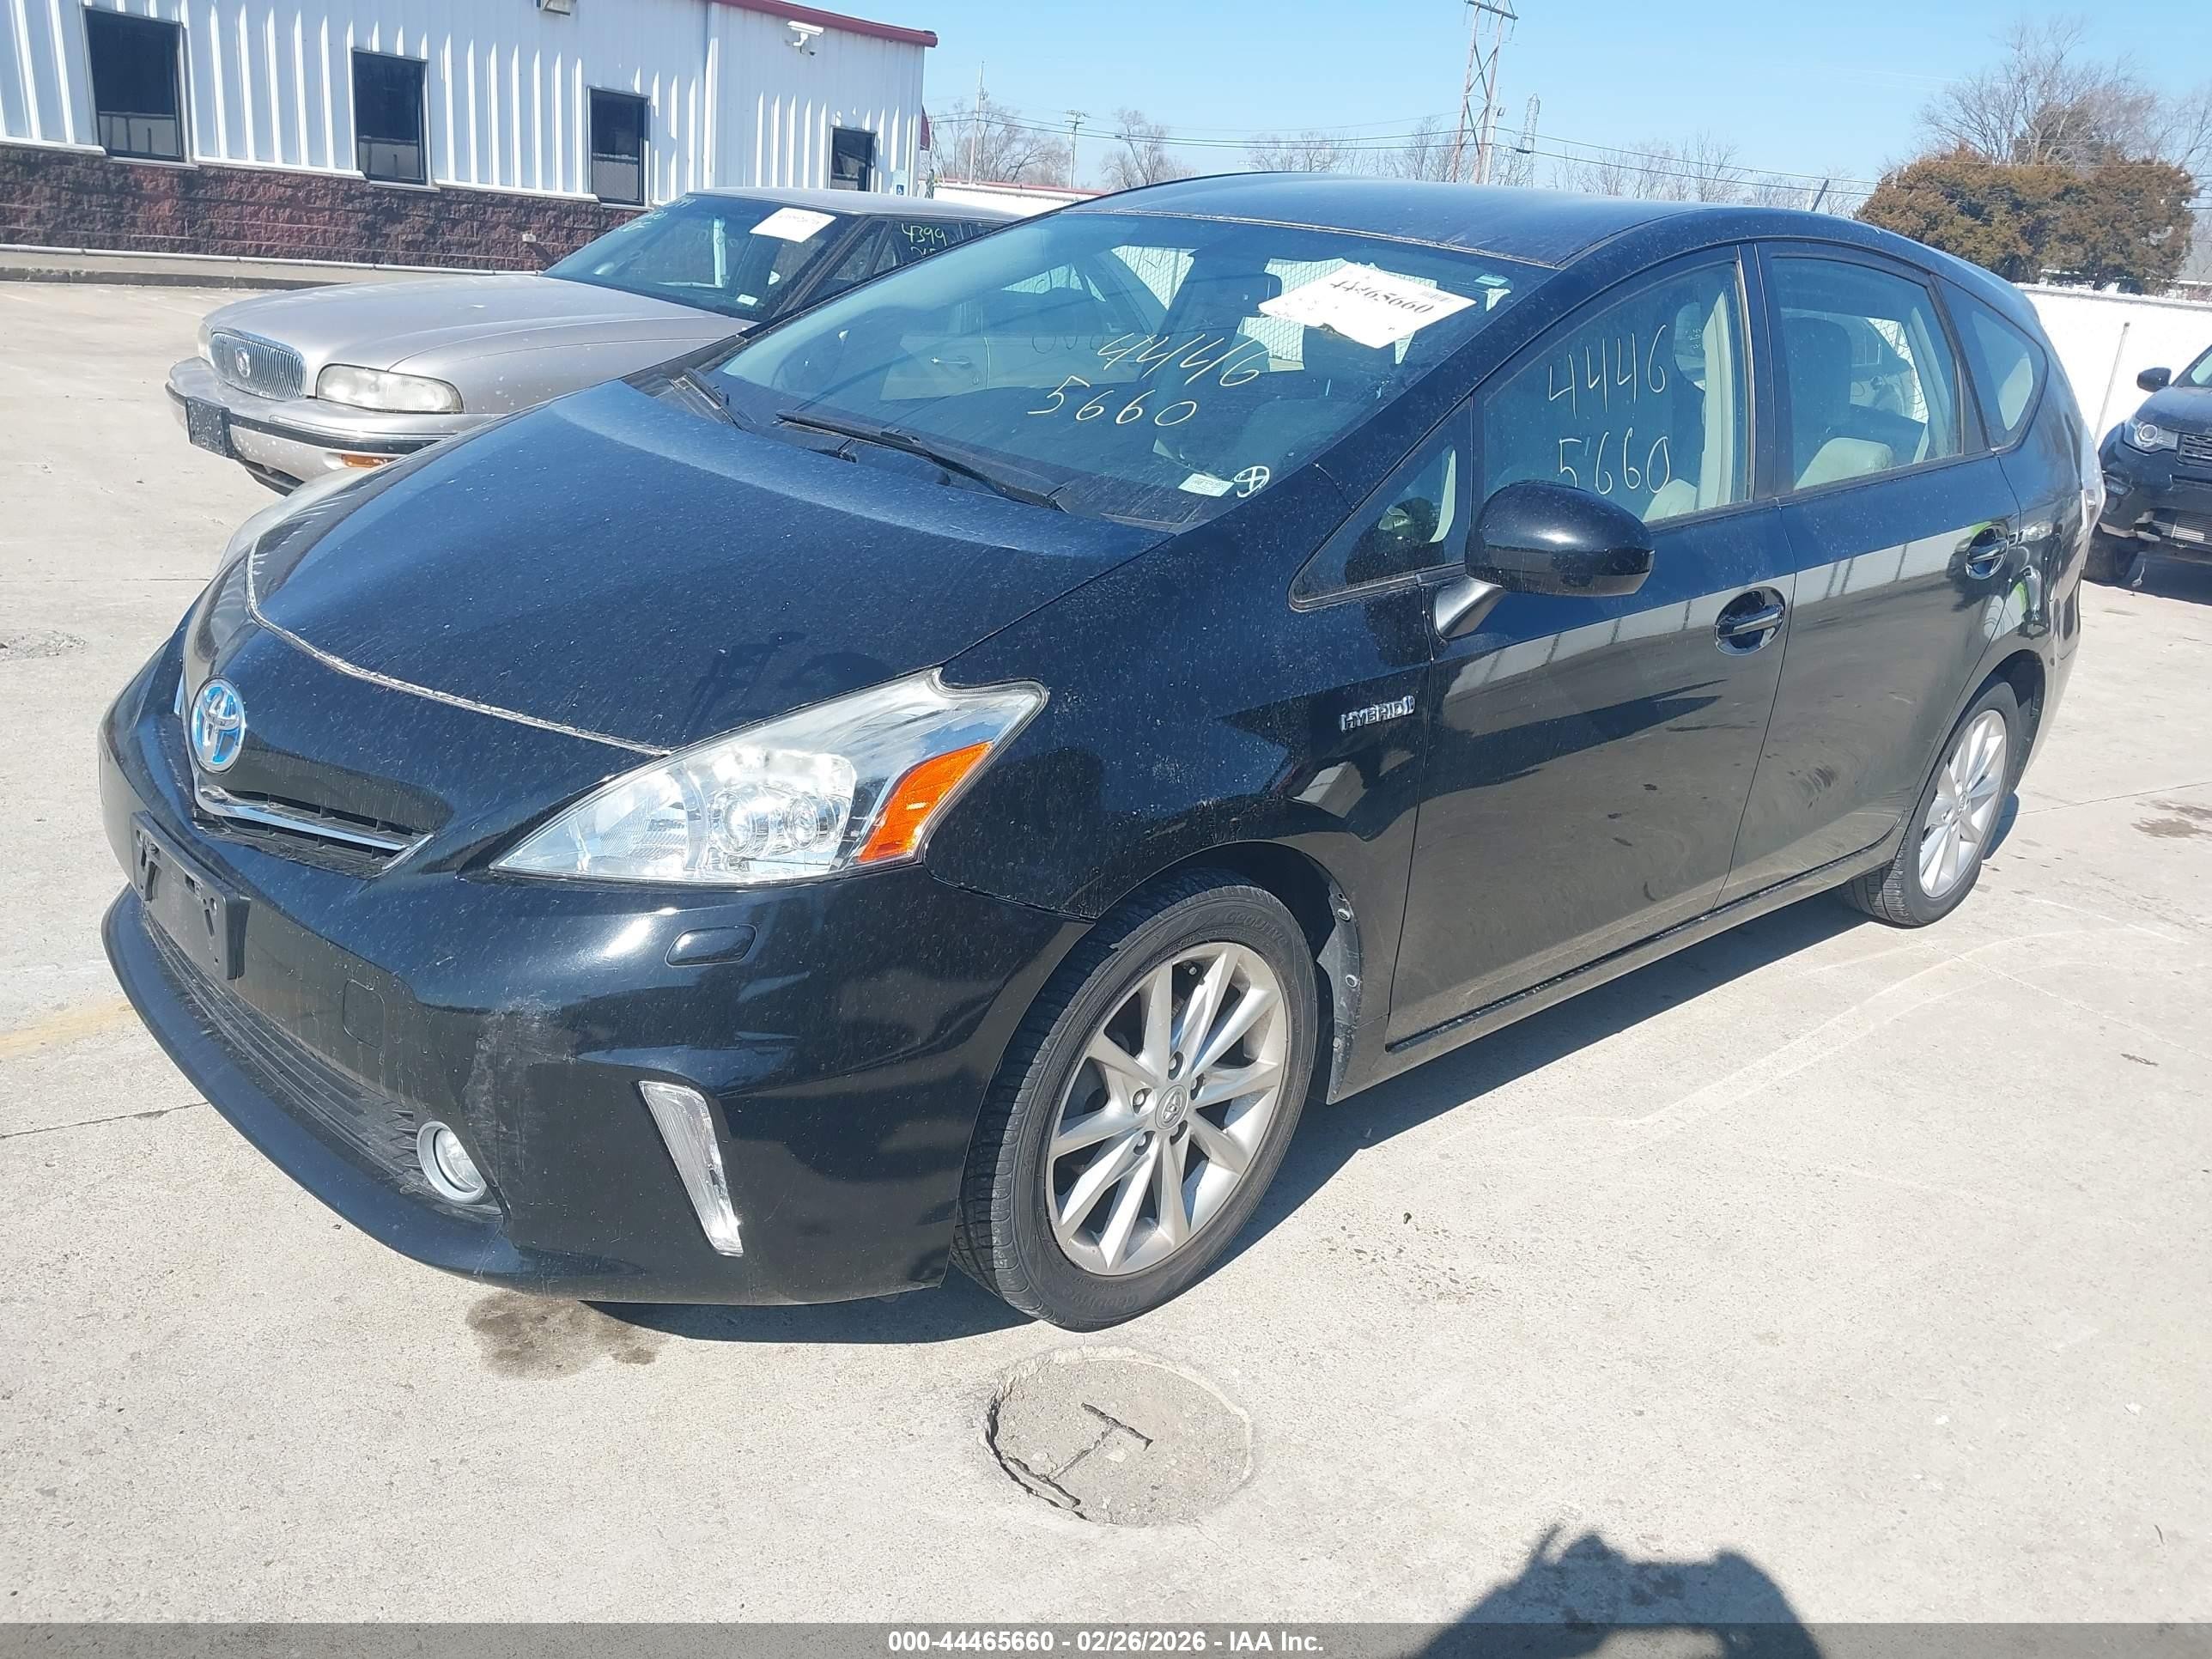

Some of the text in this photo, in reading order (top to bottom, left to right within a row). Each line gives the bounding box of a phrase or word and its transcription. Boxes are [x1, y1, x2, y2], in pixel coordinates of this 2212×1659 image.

[901, 222, 947, 246] 4399
[1097, 332, 1274, 387] 4446
[1548, 324, 1667, 419] 4446
[1027, 374, 1198, 427] 5660
[1559, 427, 1670, 495] 5660
[1340, 698, 1407, 732] HYBRID
